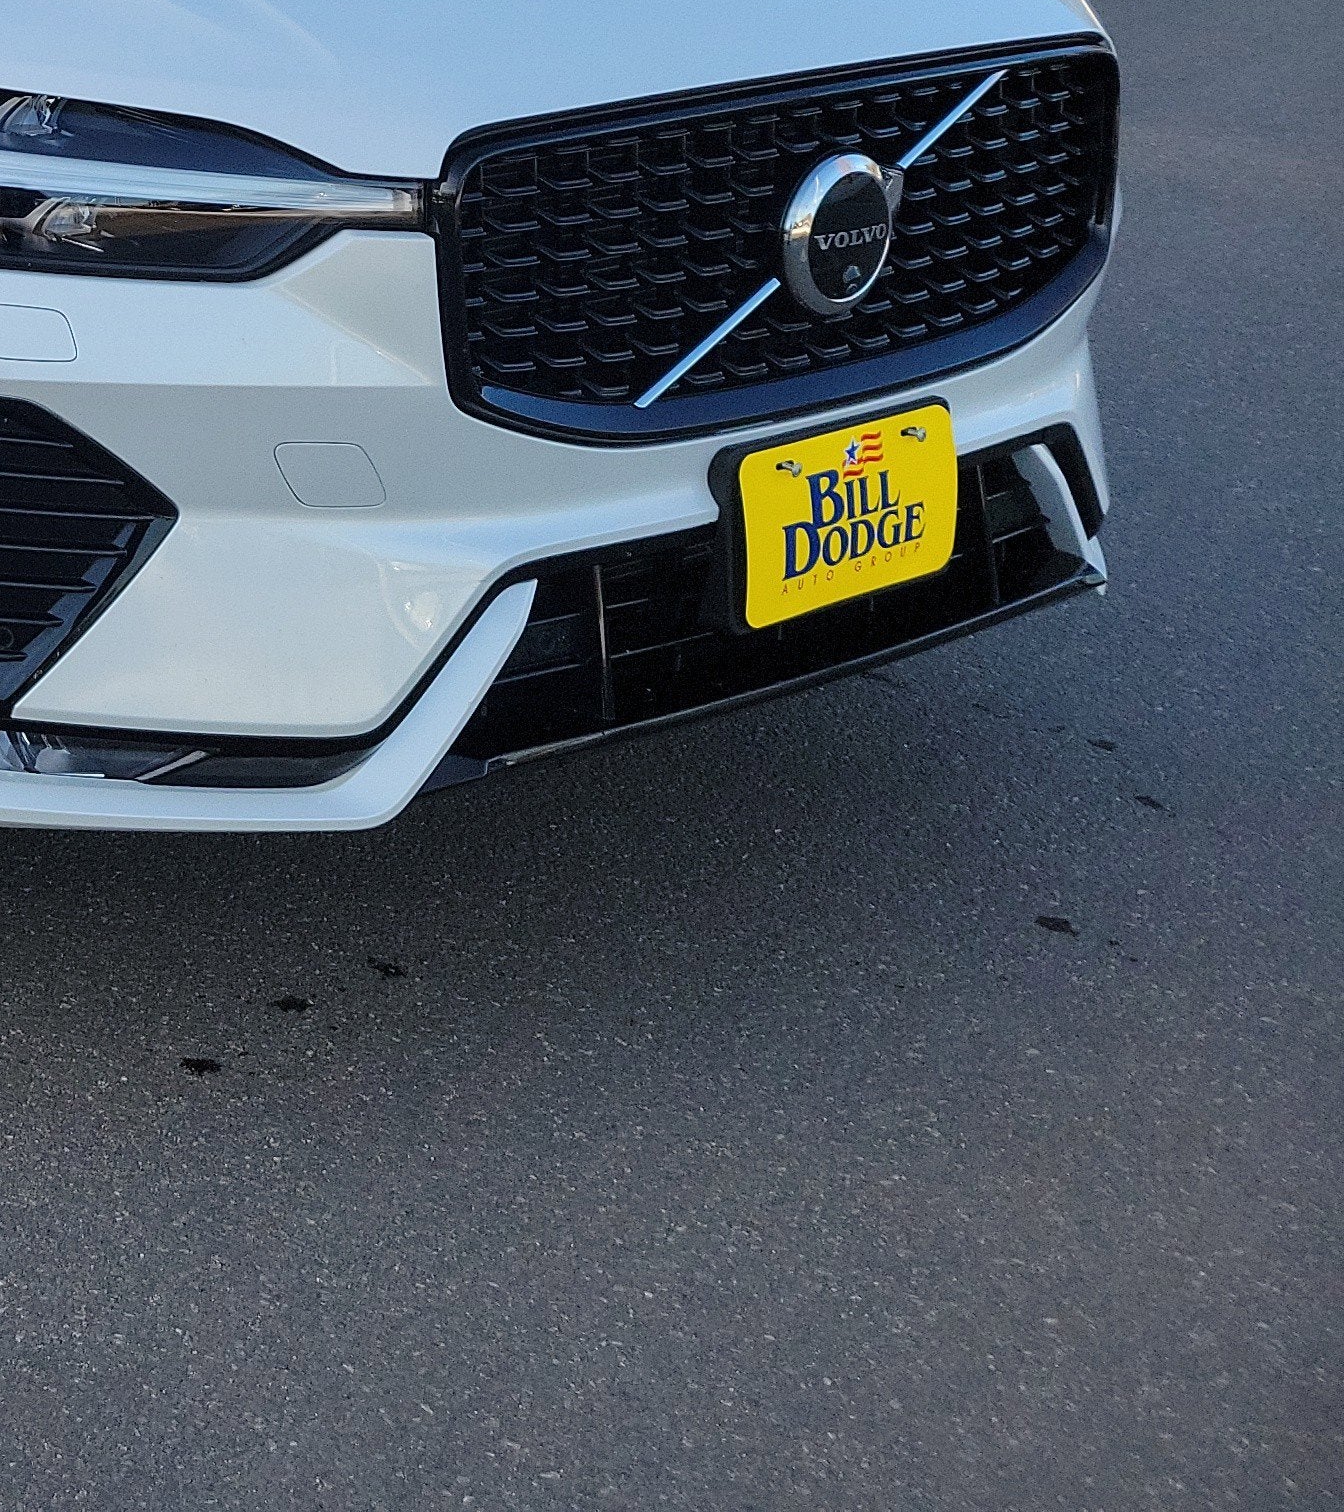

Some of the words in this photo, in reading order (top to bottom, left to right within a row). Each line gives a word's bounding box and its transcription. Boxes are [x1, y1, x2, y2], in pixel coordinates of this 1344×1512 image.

[814, 223, 887, 250] VOLVO
[805, 469, 900, 528] BILL
[781, 569, 834, 595] AUTO
[854, 542, 921, 572] GROUP
[782, 502, 926, 581] DODGE
